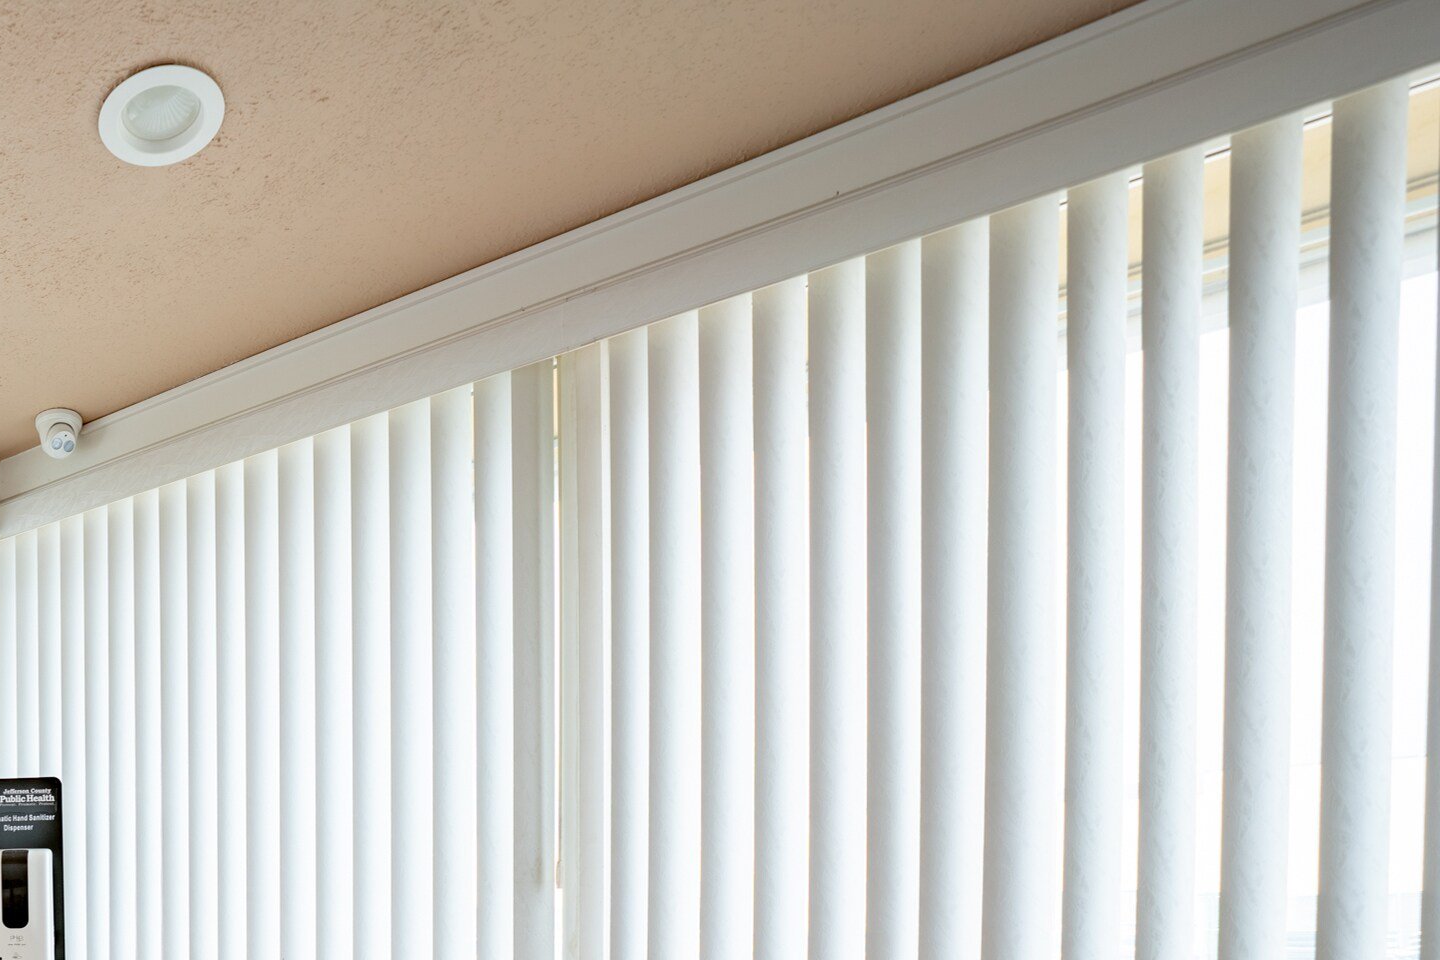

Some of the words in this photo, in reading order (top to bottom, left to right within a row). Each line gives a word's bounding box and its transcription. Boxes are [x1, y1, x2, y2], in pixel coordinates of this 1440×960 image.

[0, 795, 26, 803] Public
[26, 794, 55, 803] Health
[12, 814, 28, 822] Hand
[3, 824, 34, 832] Dispenser
